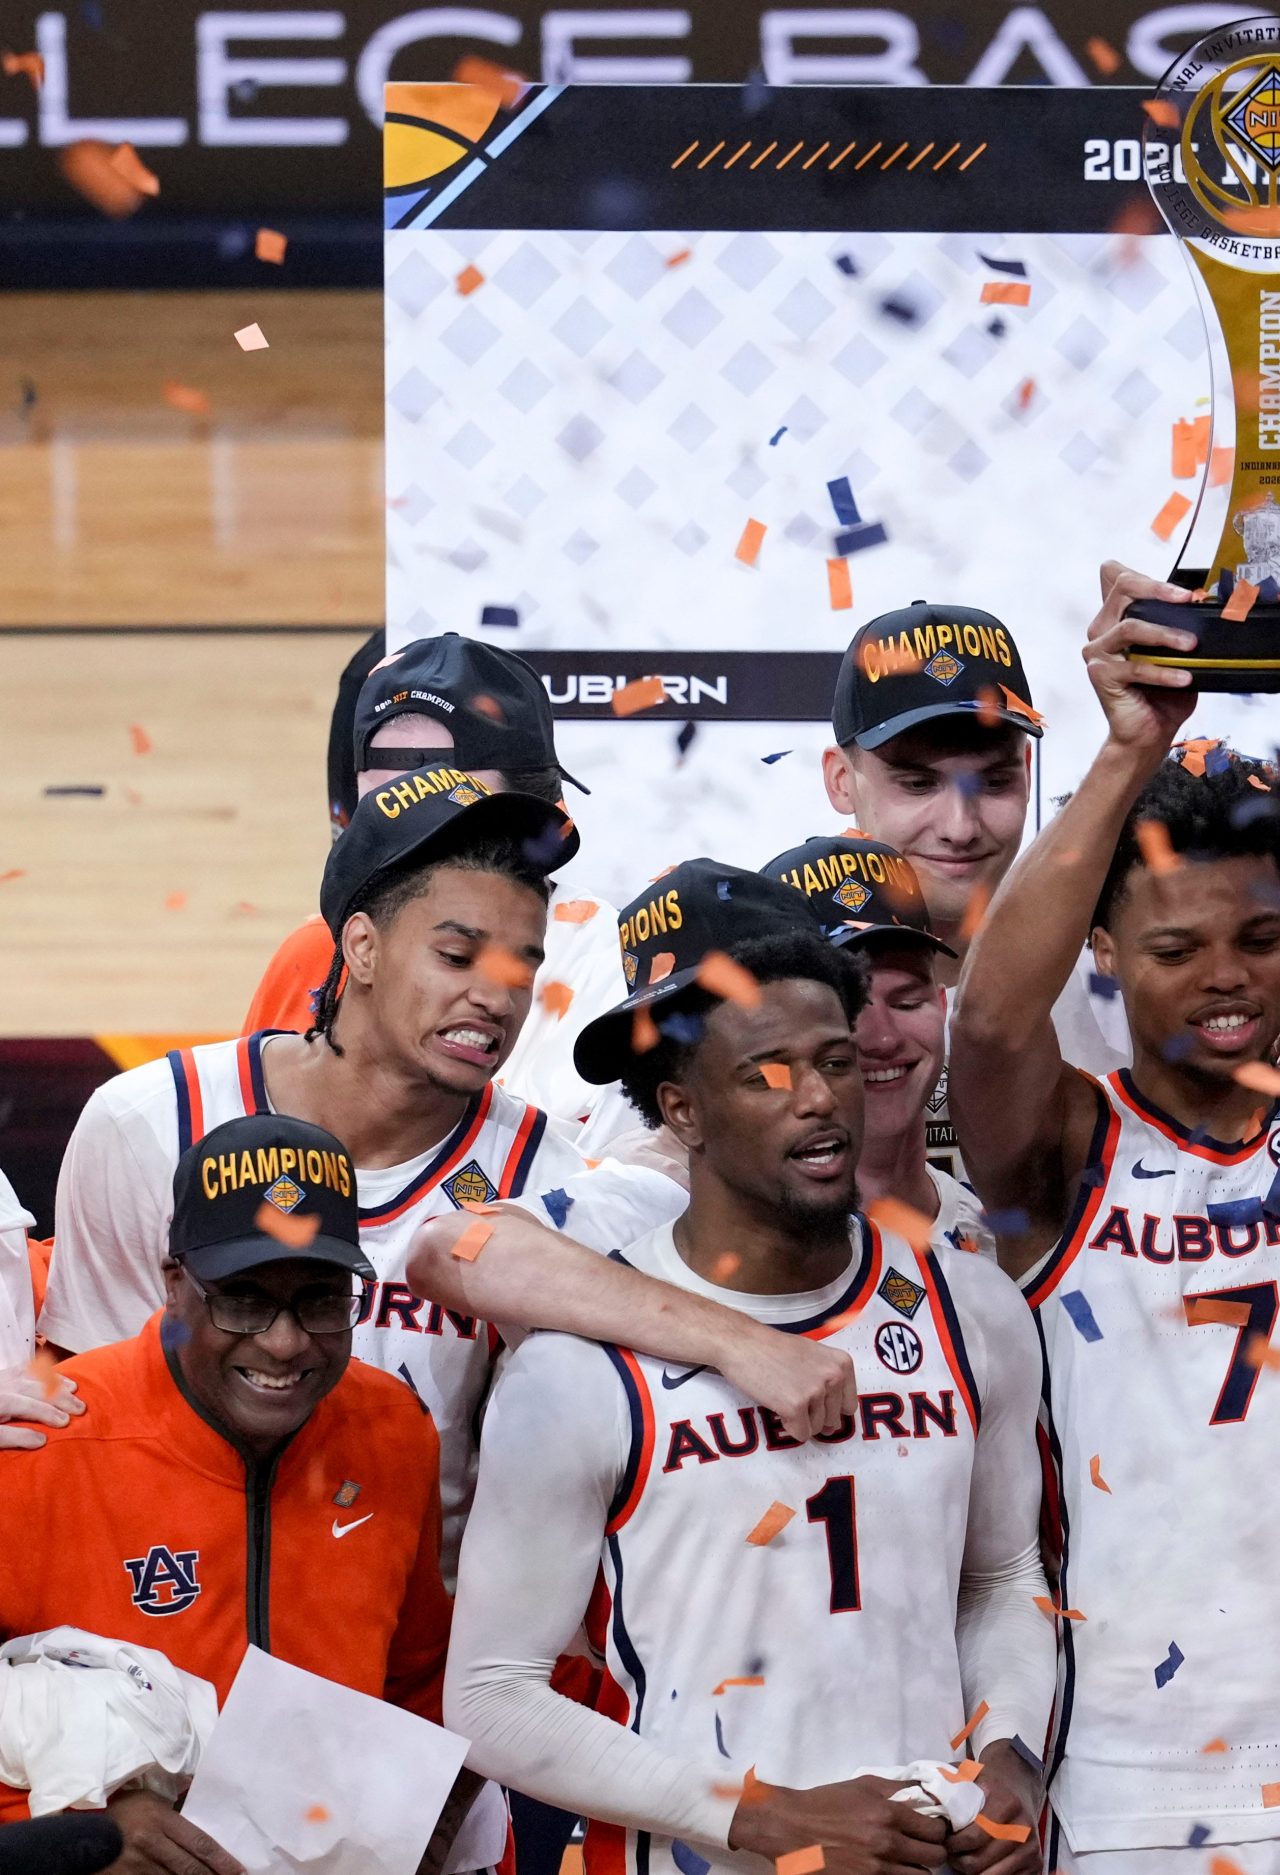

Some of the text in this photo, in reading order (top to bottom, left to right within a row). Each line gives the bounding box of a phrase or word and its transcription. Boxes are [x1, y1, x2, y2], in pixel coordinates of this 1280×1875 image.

[0, 10, 692, 147] LEGE
[863, 623, 1012, 684] CHAMPIONS
[392, 690, 409, 704] NIT
[410, 689, 456, 714] CHAMPION
[202, 1146, 351, 1201] CHAMPIONS
[272, 1189, 299, 1199] NIT
[454, 1182, 486, 1198] NIT
[878, 1325, 920, 1371] SEC
[1183, 1280, 1280, 1425] 7
[806, 1475, 862, 1615] 1
